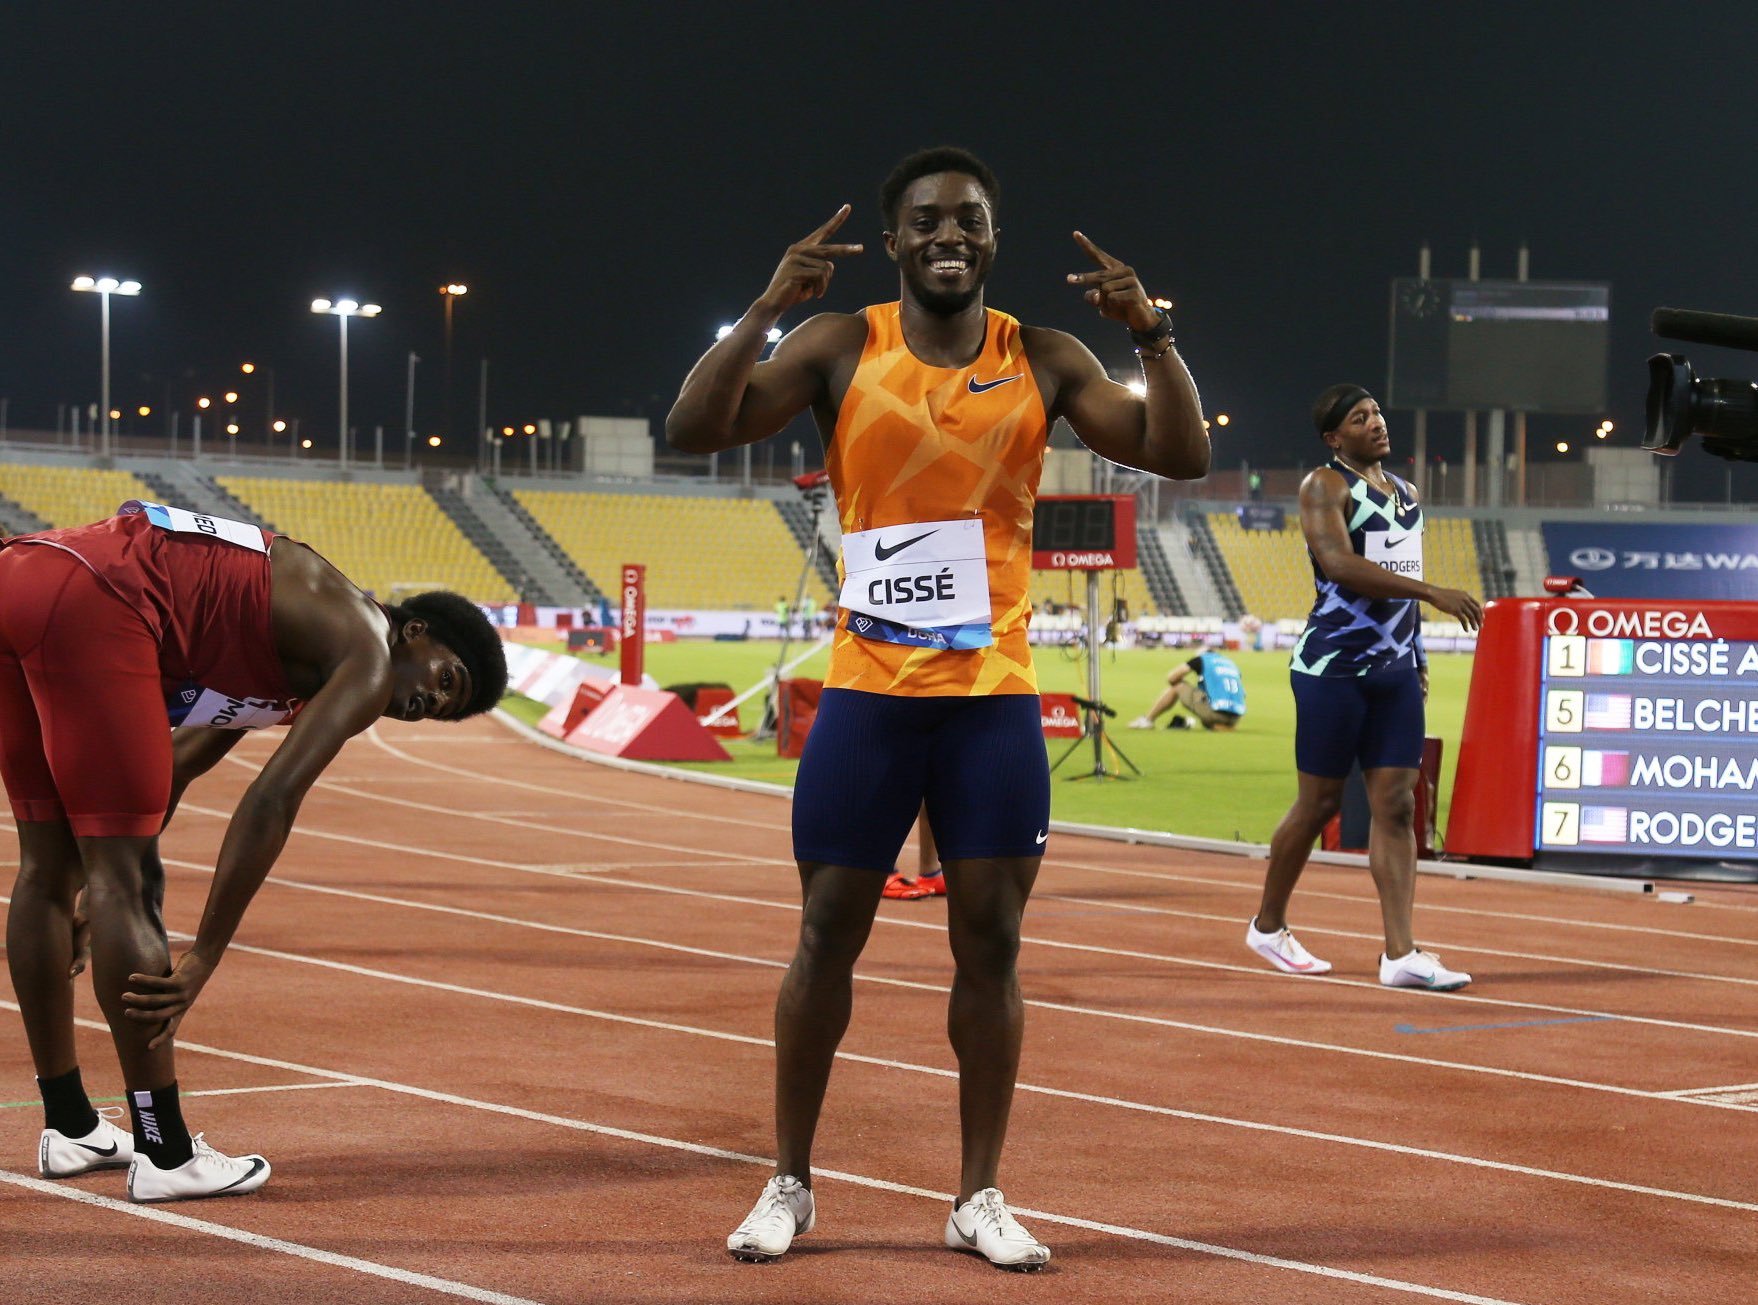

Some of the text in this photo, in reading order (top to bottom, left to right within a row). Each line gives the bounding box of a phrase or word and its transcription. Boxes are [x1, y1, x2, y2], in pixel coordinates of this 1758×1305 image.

[1066, 553, 1114, 567] OMEGA
[1376, 560, 1421, 573] ODGERS
[868, 567, 956, 606] CISSÉ
[623, 585, 639, 638] OMEGA
[1587, 610, 1713, 639] OMEGA
[1559, 637, 1758, 676] 1 CISSÉ A
[1041, 716, 1079, 728] OMEGA
[1556, 698, 1758, 733] 5 BELCHE
[1554, 754, 1571, 781] 6
[1553, 810, 1569, 837] 7
[138, 1109, 164, 1145] NIKE
